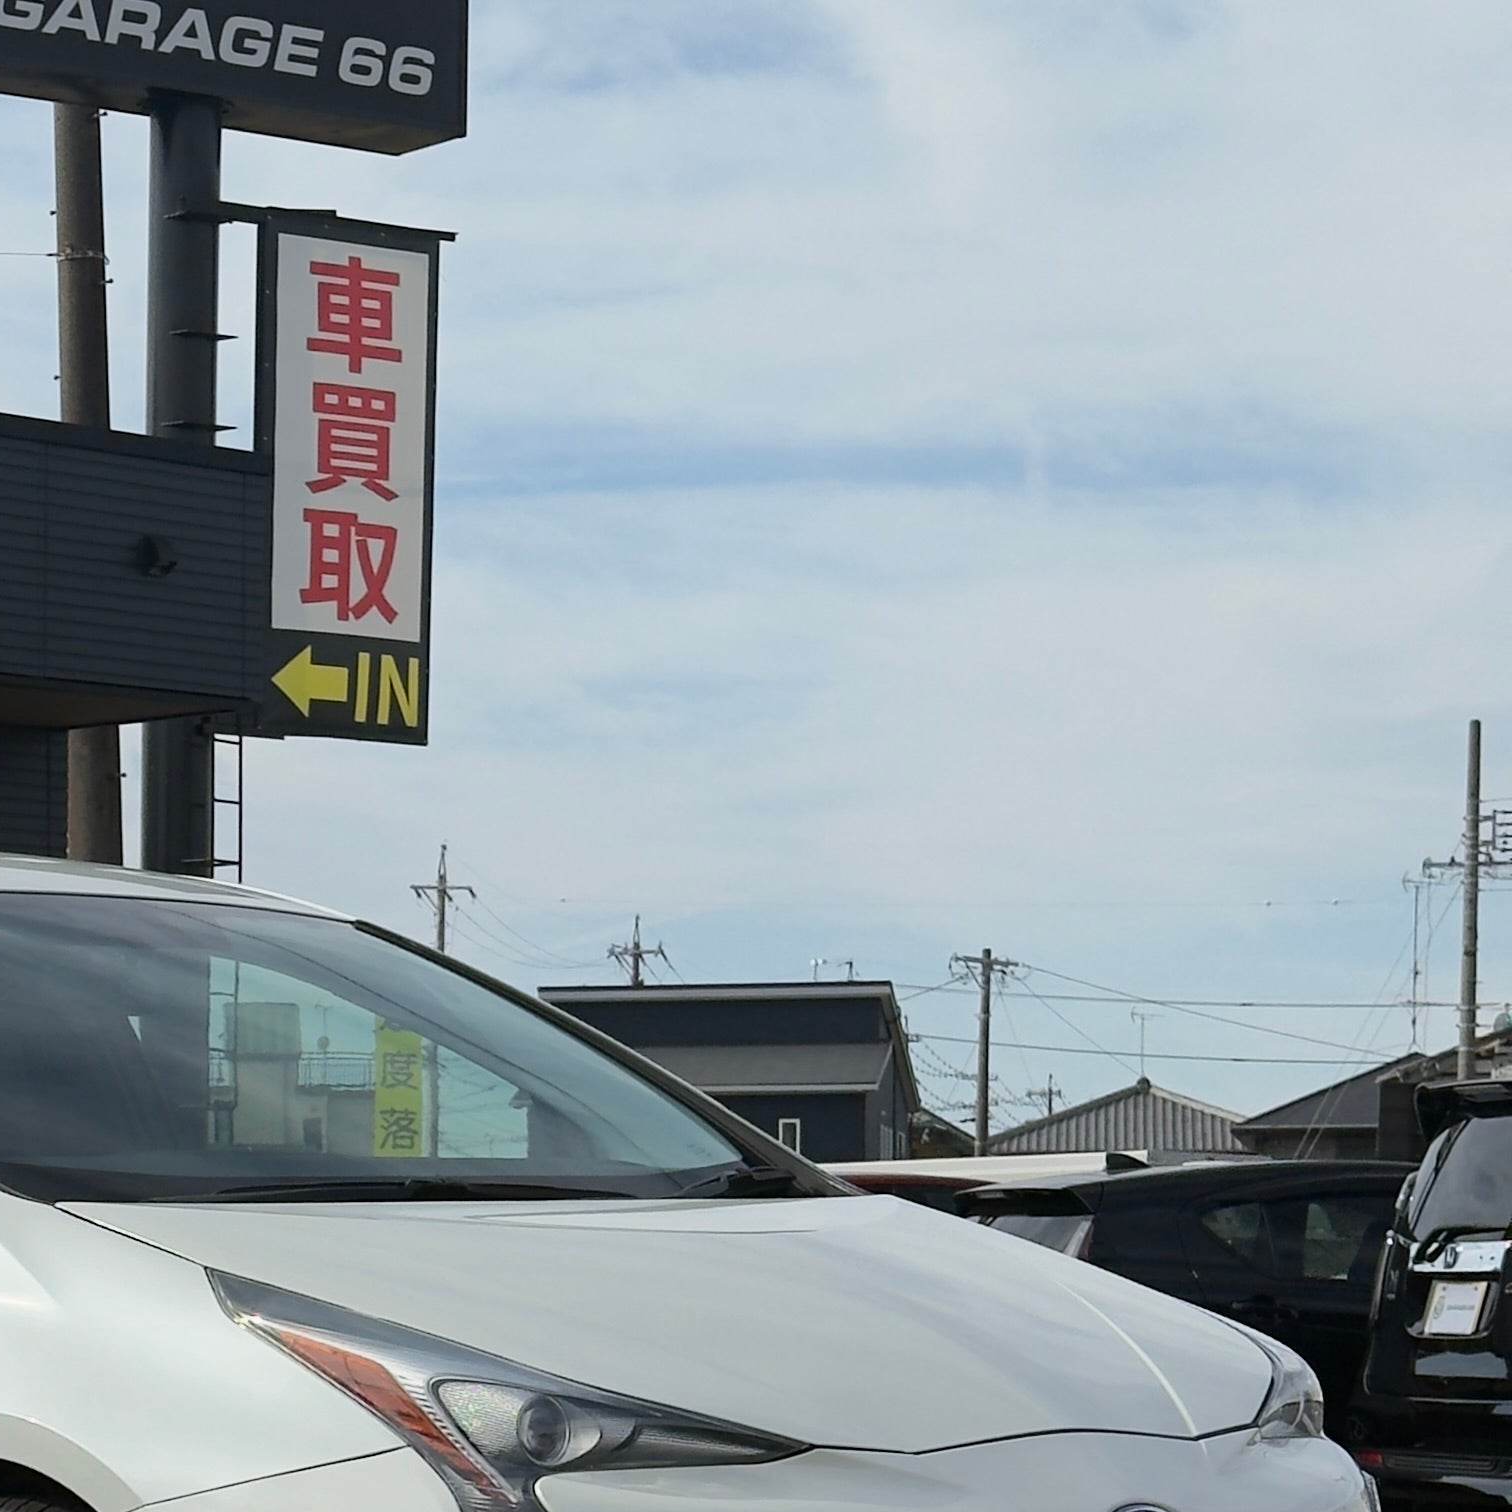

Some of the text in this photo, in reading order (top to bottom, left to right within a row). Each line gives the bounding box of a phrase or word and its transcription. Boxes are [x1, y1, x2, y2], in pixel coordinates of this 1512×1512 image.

[338, 37, 435, 95] 66
[299, 256, 402, 624] 車買取
[354, 652, 419, 727] IN
